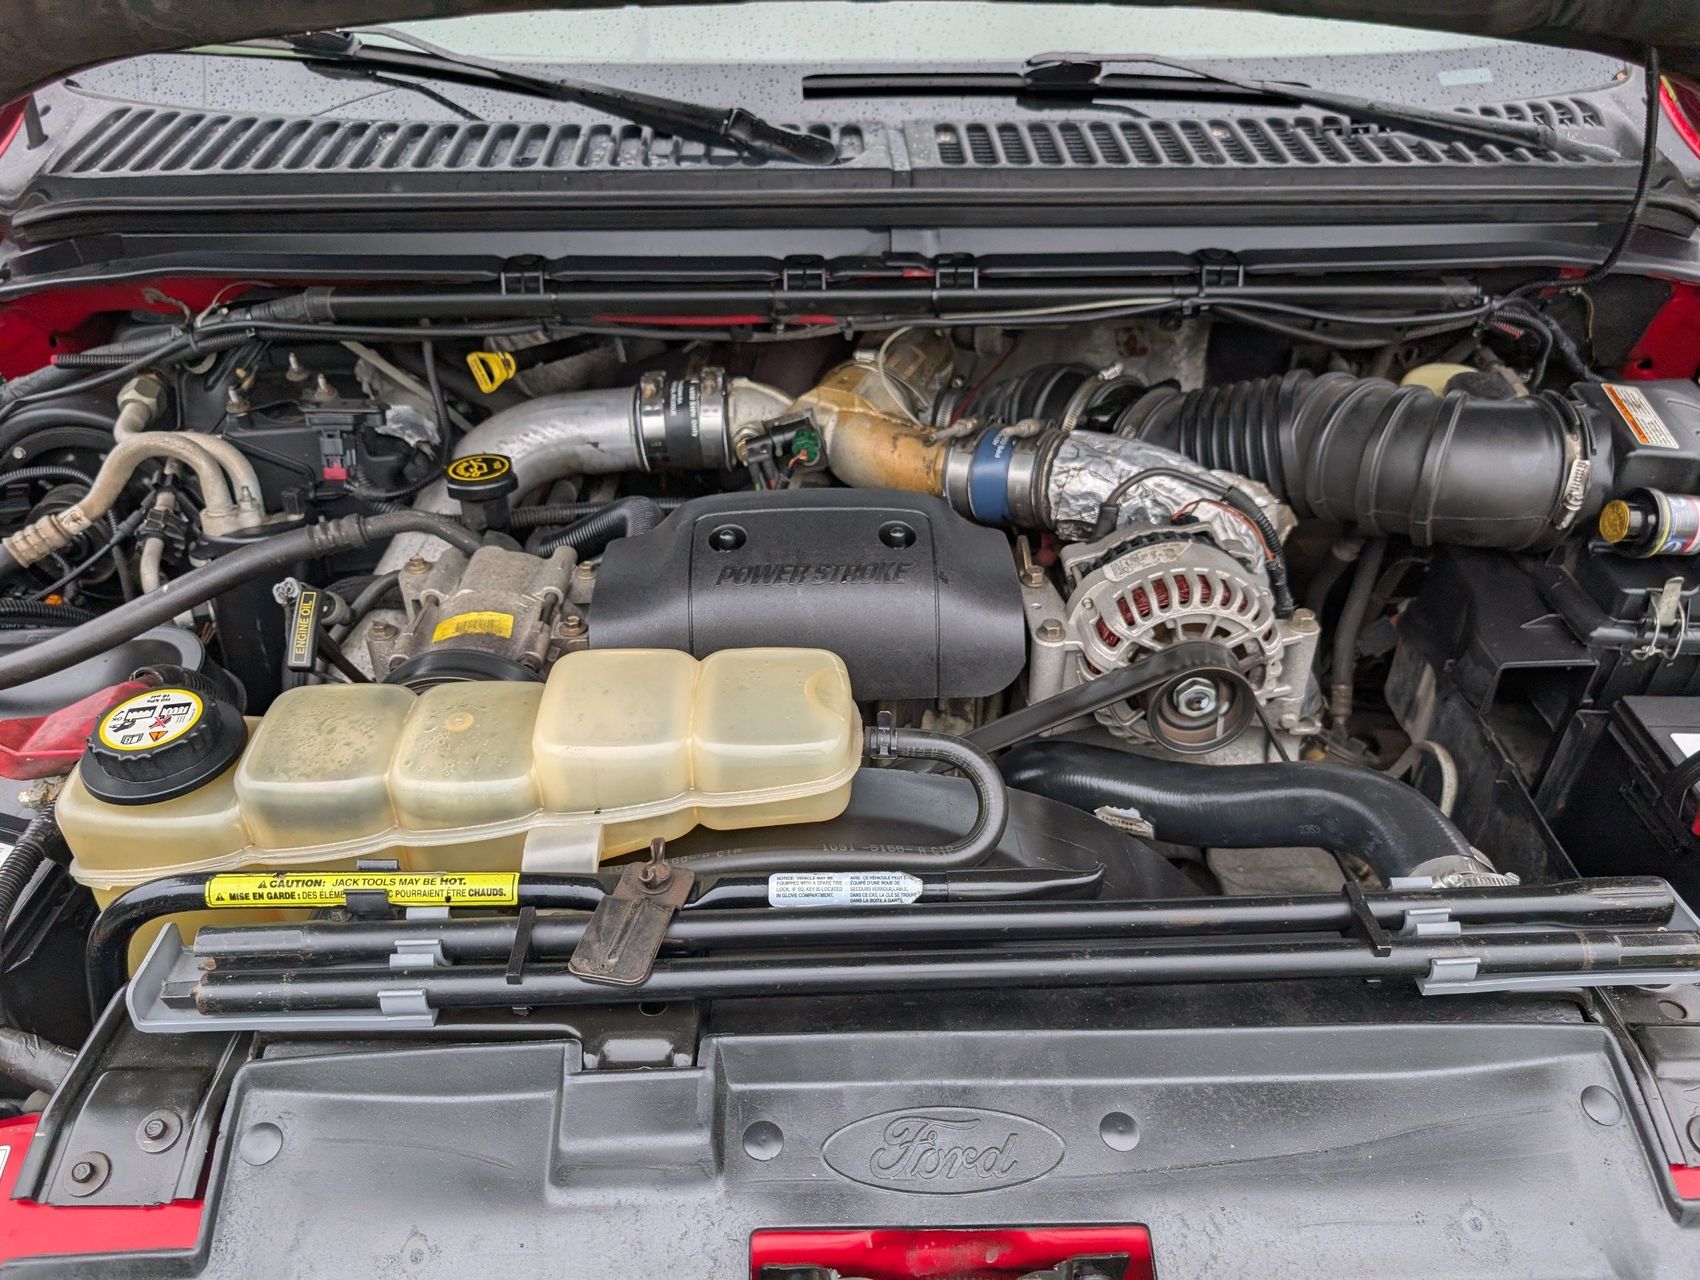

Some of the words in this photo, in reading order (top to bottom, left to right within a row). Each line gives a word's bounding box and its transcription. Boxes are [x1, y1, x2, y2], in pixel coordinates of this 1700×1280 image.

[715, 562, 811, 587] POWER
[811, 561, 913, 585] STROKE
[301, 600, 313, 616] OIL
[295, 617, 310, 655] ENGINE
[269, 879, 326, 888] CAUTION:
[332, 878, 360, 887] JACK
[362, 878, 396, 887] TOOLS
[399, 877, 421, 886] MAY
[423, 877, 437, 886] BE
[440, 877, 467, 886] HOT.
[228, 892, 251, 901] MISE
[252, 892, 264, 900] EN
[302, 891, 317, 900] DES
[319, 888, 346, 900] ÉLÉME
[395, 889, 444, 898] POURRAIENT
[446, 887, 466, 898] ÊTRE
[468, 887, 507, 897] CHAUDS.
[870, 1115, 1019, 1180] Ford
